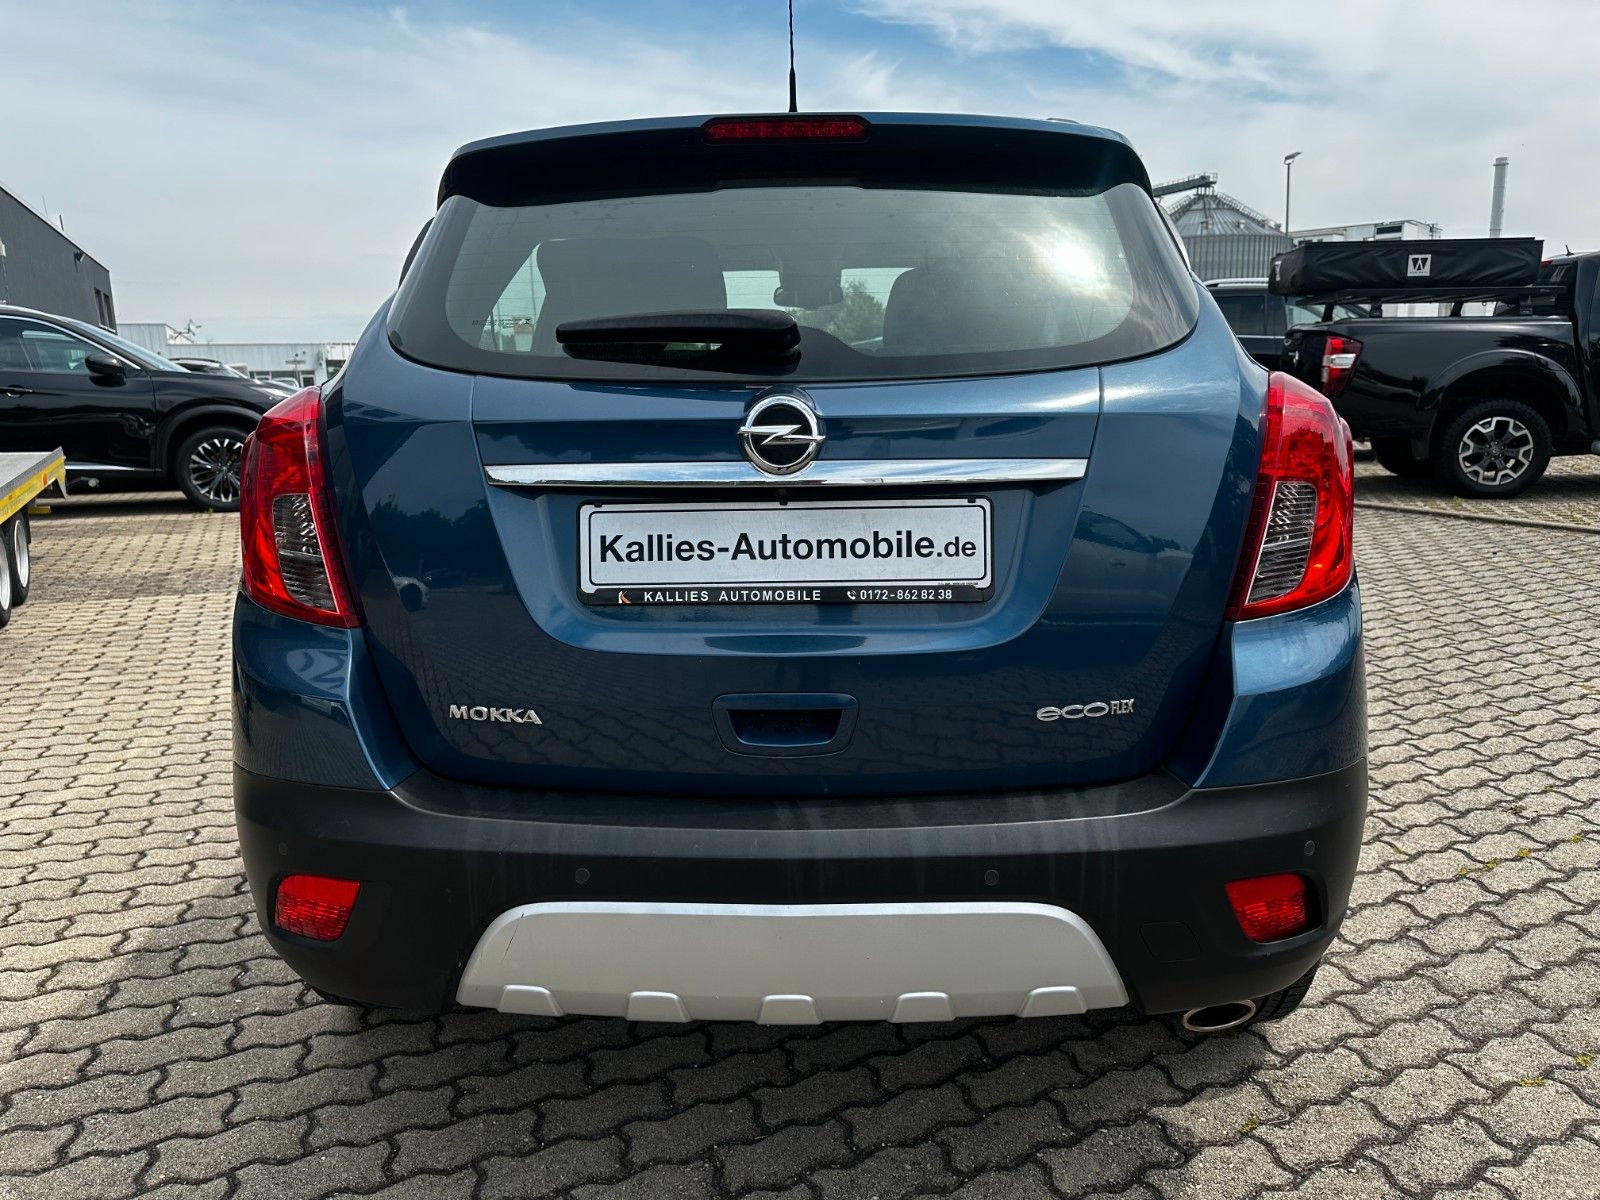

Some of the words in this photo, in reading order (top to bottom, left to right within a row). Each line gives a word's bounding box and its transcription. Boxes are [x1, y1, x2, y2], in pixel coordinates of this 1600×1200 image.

[599, 530, 977, 562] Kallies-Automobile.de
[644, 590, 709, 602] KALLIES
[719, 589, 822, 601] AUTOMOBILE
[860, 589, 918, 600] 0172-862
[921, 589, 935, 600] 82
[938, 589, 952, 600] 38
[449, 704, 543, 725] MOKKA
